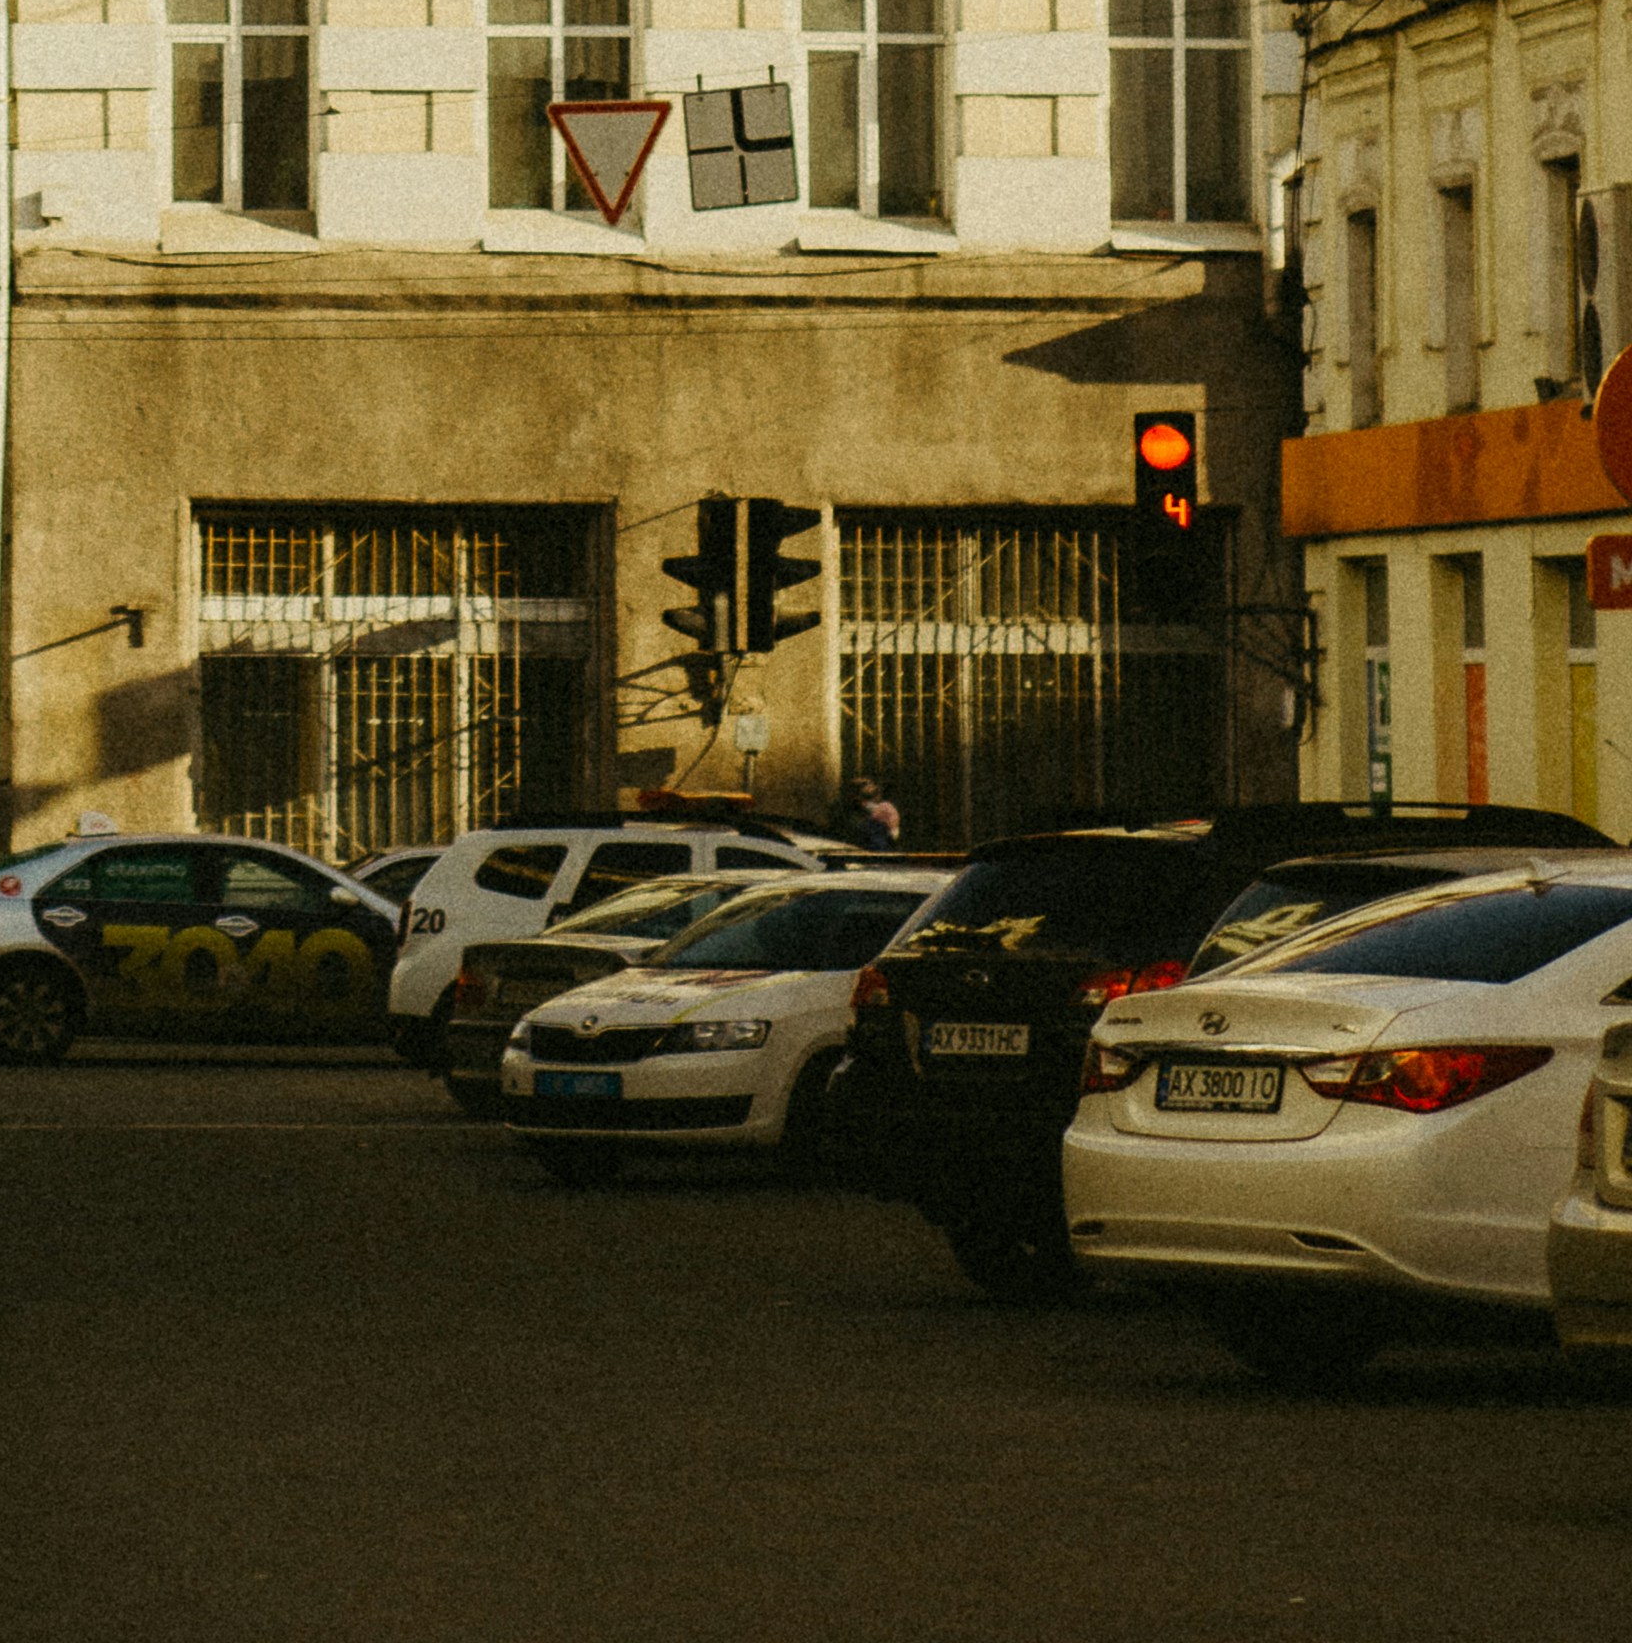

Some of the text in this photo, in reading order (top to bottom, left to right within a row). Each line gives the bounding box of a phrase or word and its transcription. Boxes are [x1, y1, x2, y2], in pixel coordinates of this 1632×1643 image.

[1164, 493, 1189, 530] 4
[411, 907, 446, 934] 20
[931, 1026, 957, 1049] AX
[1169, 1069, 1198, 1097] AX
[1199, 1070, 1245, 1098] 3800
